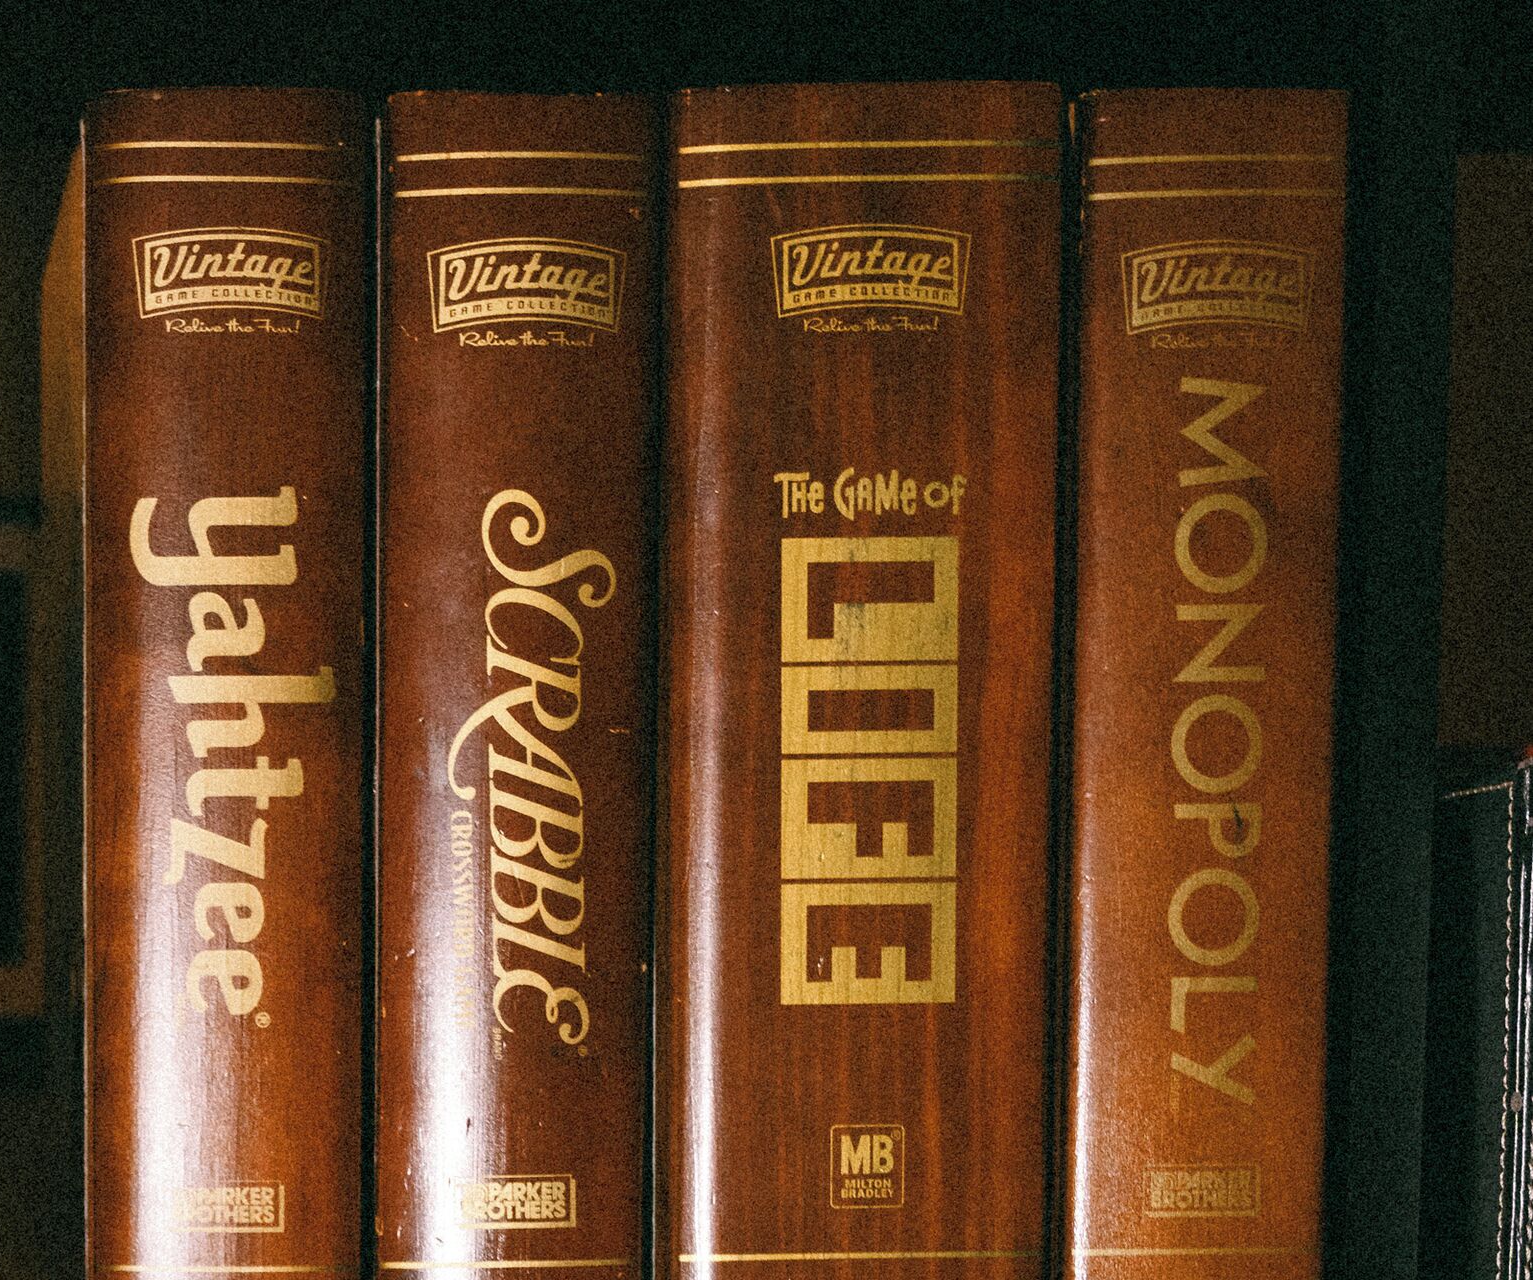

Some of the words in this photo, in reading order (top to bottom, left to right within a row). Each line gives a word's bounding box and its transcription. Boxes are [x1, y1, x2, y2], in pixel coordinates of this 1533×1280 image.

[152, 242, 314, 292] Vintage
[447, 256, 609, 302] Vintage
[792, 239, 953, 286] Vintage
[154, 289, 200, 305] GAME
[210, 286, 319, 306] COLLECTION
[793, 288, 839, 303] GAME
[849, 284, 954, 302] COLLECTION
[1168, 376, 1267, 1106] MONOPOLY
[449, 489, 616, 1046] SCRABBLE
[781, 537, 958, 1005] LIFE
[840, 1134, 894, 1174] MB
[840, 1187, 894, 1200] BRADLEY
[844, 1178, 892, 1189] MILTON
